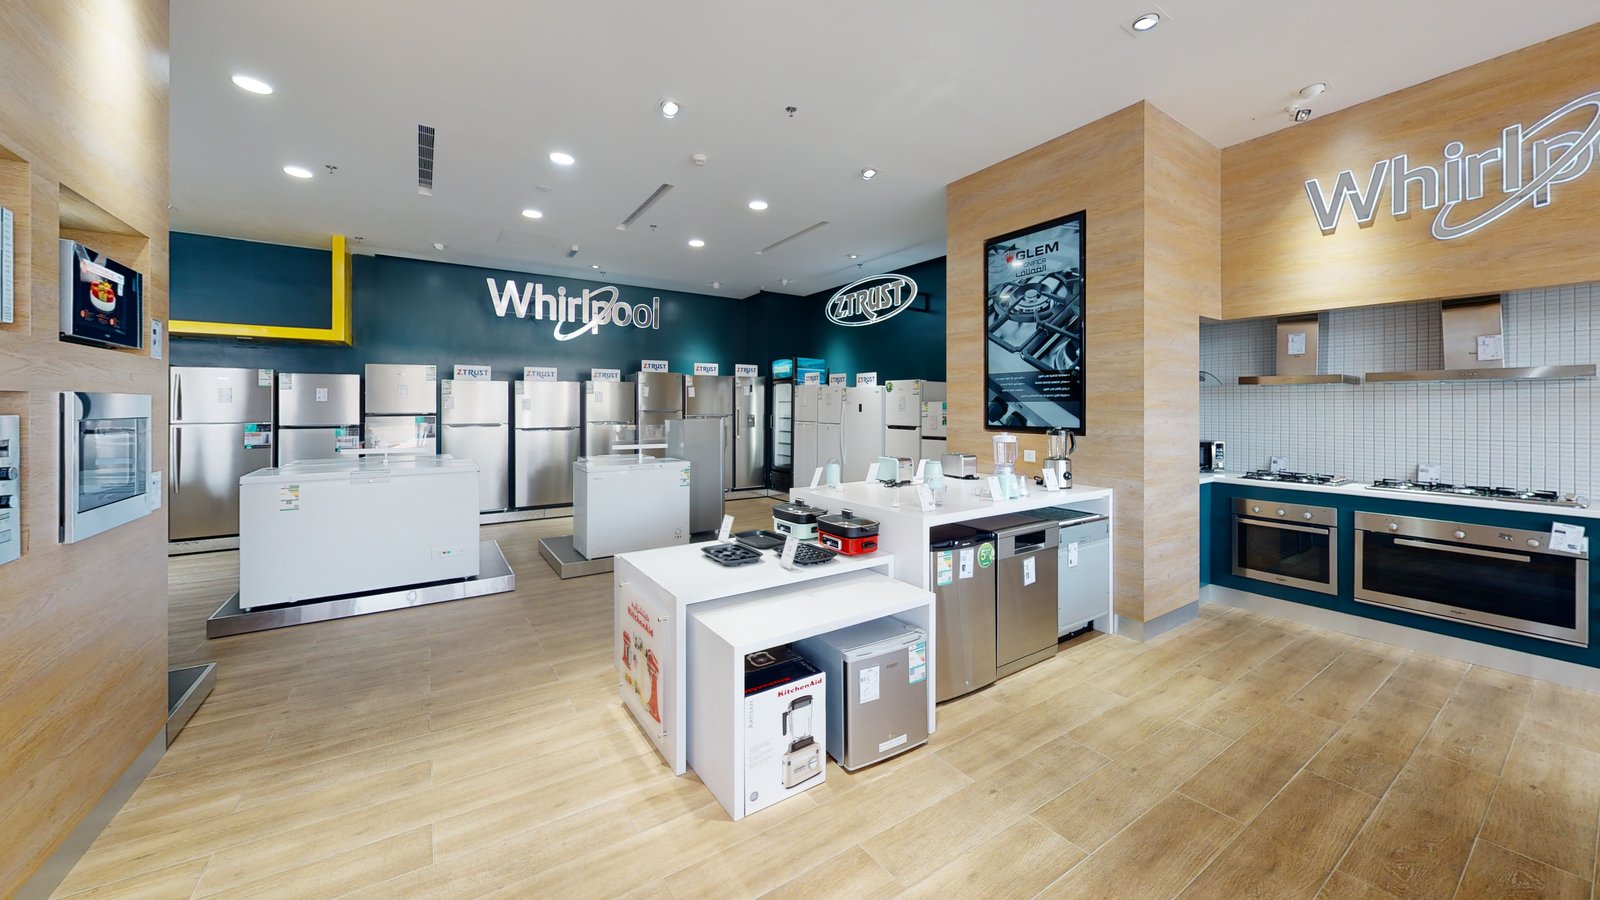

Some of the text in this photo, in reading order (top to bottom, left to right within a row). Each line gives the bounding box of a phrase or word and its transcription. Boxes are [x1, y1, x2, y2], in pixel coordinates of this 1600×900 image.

[1304, 118, 1600, 235] Whirlp
[1016, 241, 1059, 260] GLEM
[486, 277, 660, 339] Whirlpool
[628, 606, 654, 637] KitchenAid
[777, 678, 823, 697] KitchenAid
